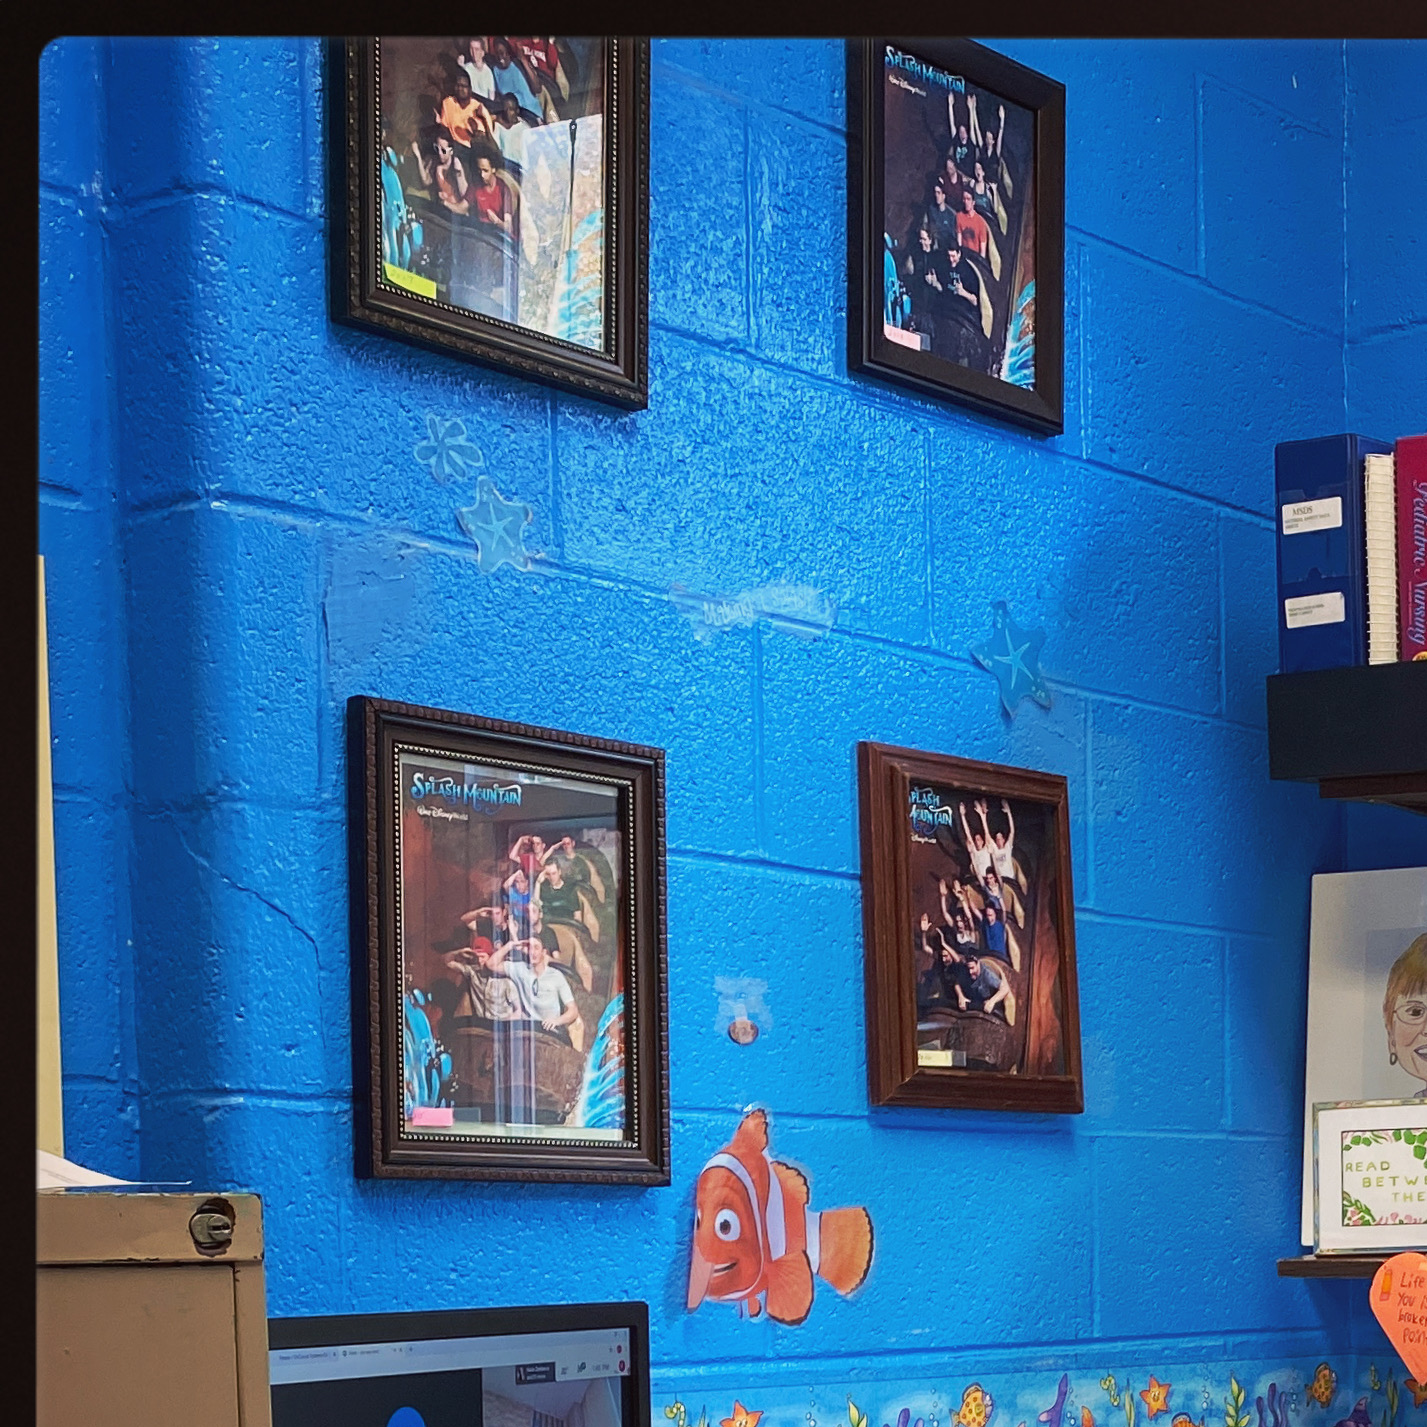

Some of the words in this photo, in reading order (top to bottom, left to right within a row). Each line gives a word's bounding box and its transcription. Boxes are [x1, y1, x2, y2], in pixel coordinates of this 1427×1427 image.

[1292, 506, 1313, 517] MSDS
[410, 772, 462, 800] SPLASH
[463, 783, 522, 812] MOUNTAIN
[1345, 1160, 1391, 1172] READ
[1392, 1191, 1426, 1202] THE
[1400, 1271, 1425, 1289] Life
